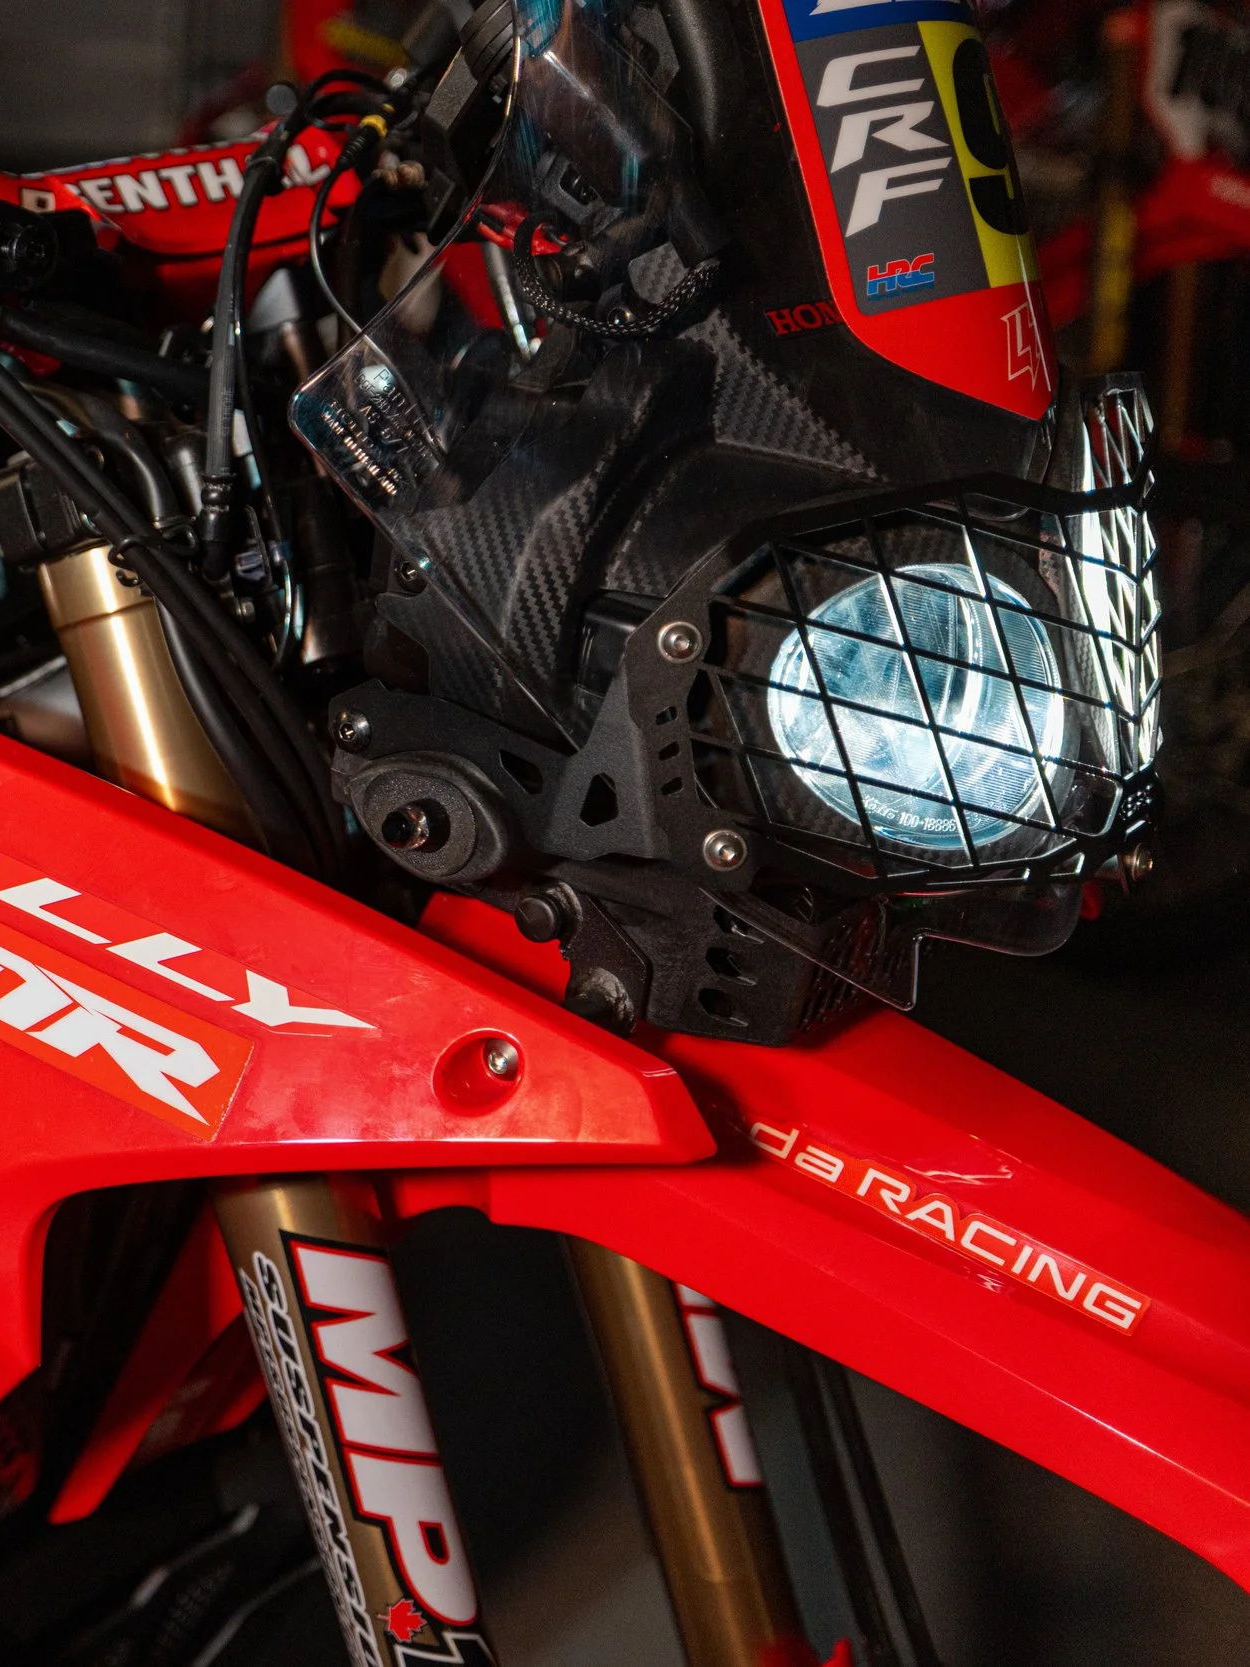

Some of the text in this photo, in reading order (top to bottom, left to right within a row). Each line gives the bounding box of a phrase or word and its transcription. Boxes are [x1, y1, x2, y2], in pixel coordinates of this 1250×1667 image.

[21, 145, 330, 214] ENTHL
[816, 45, 952, 238] CRF
[952, 38, 1028, 235] 9
[867, 252, 935, 296] HRC
[751, 1121, 1143, 1331] da RACING
